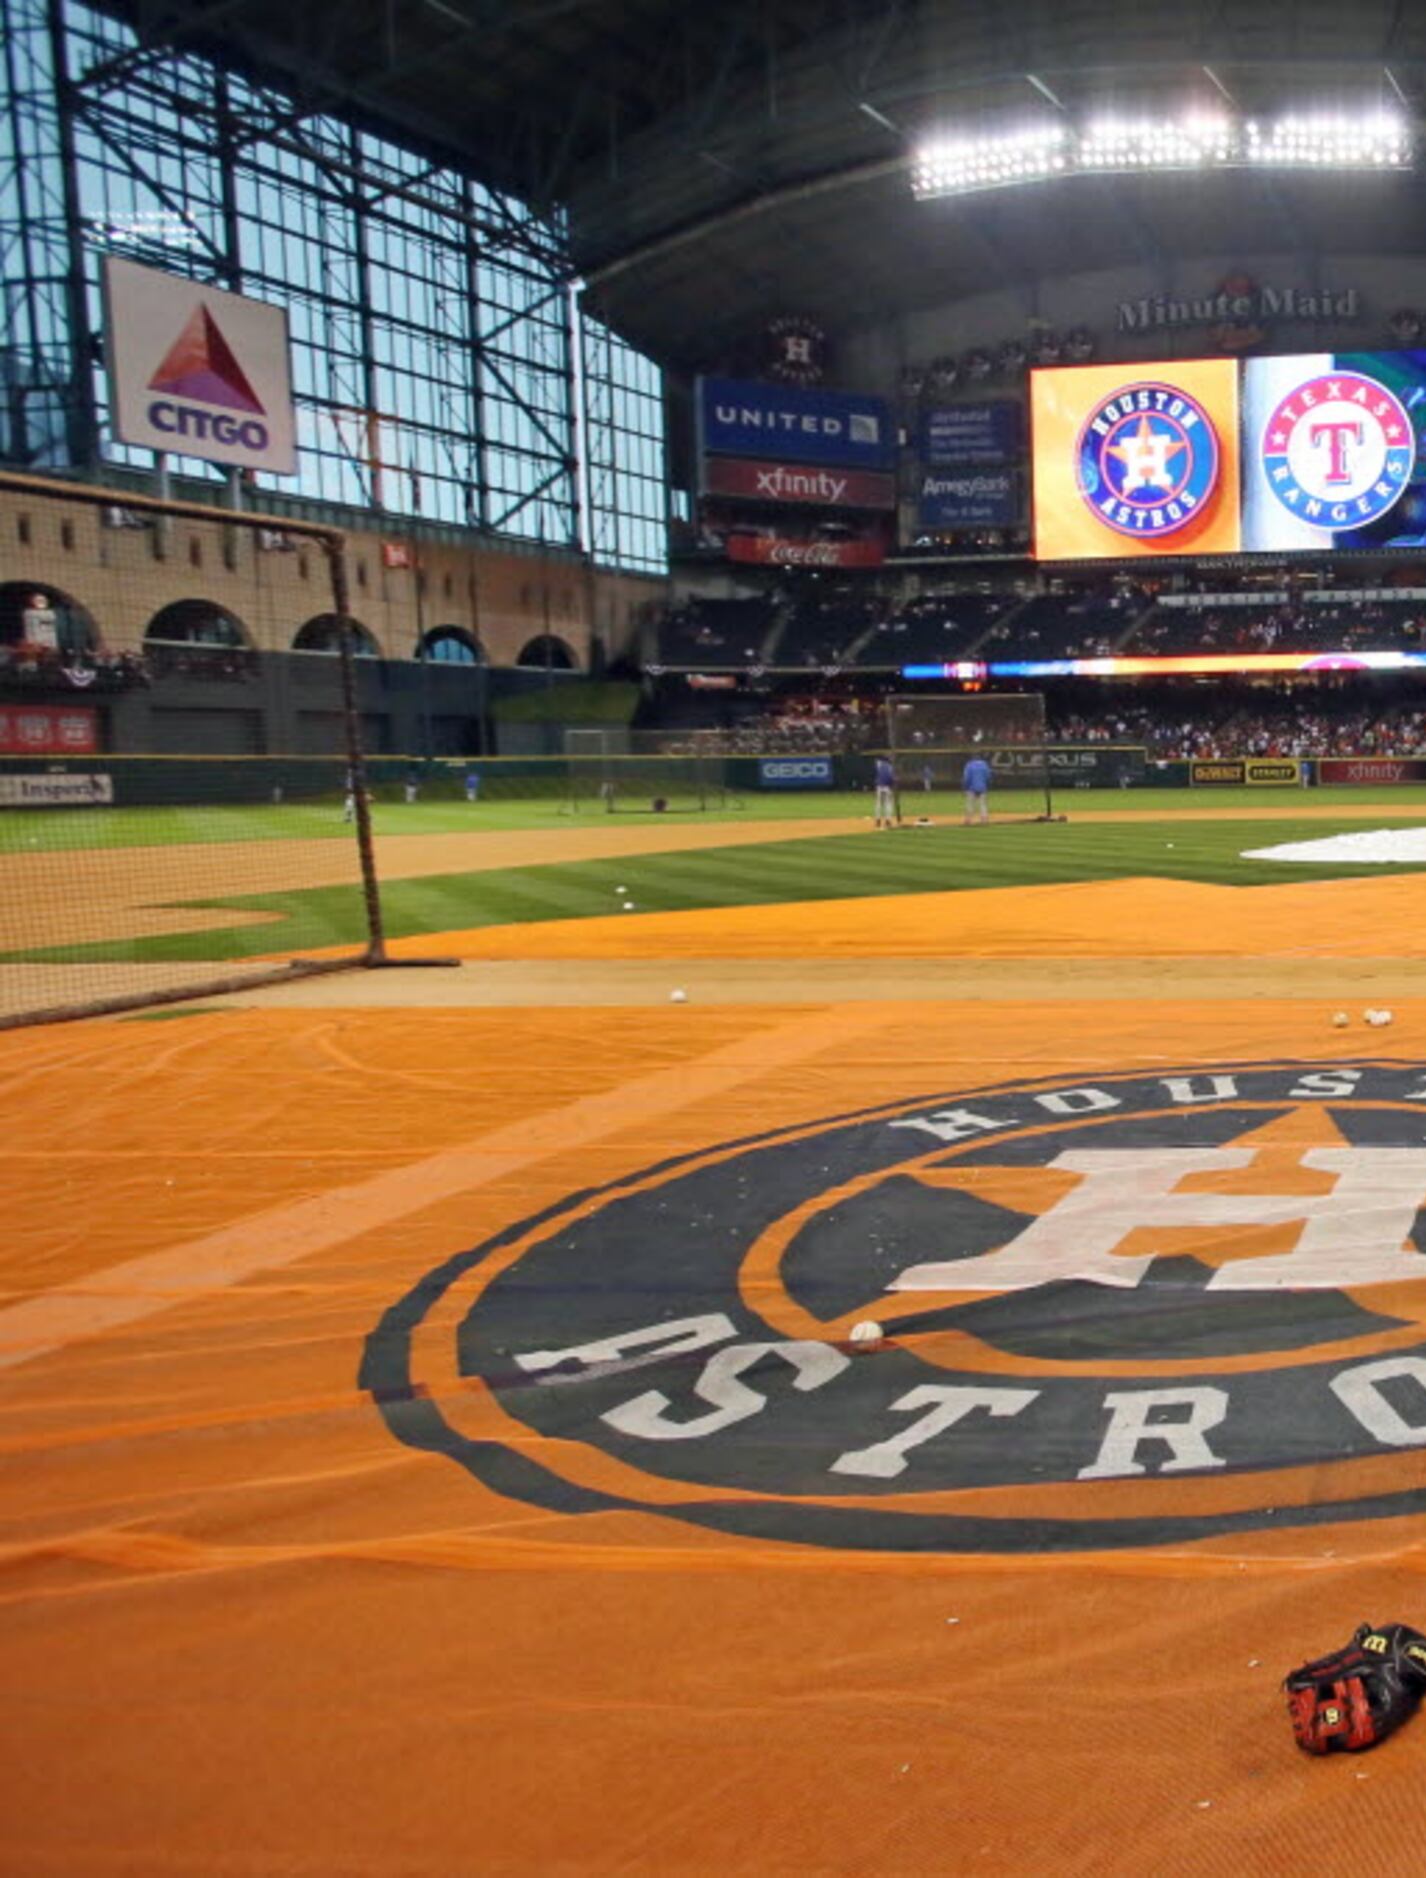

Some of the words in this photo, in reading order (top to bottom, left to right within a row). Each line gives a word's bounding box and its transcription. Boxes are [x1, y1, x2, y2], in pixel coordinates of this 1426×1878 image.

[1116, 292, 1250, 331] Minute
[1260, 286, 1357, 317] Maid
[714, 405, 843, 435] UNITED
[1091, 390, 1199, 436] HOUSTON
[1280, 381, 1391, 422] TEXAS
[147, 400, 269, 451] CITGO
[1119, 433, 1174, 487] H
[1310, 421, 1365, 486] T
[756, 467, 848, 502] xfinity
[1271, 460, 1403, 522] RANGERS
[1099, 490, 1198, 528] ASTROS
[762, 762, 829, 779] GEICO
[1017, 752, 1097, 767] LEXUS
[1347, 762, 1405, 782] xfinity
